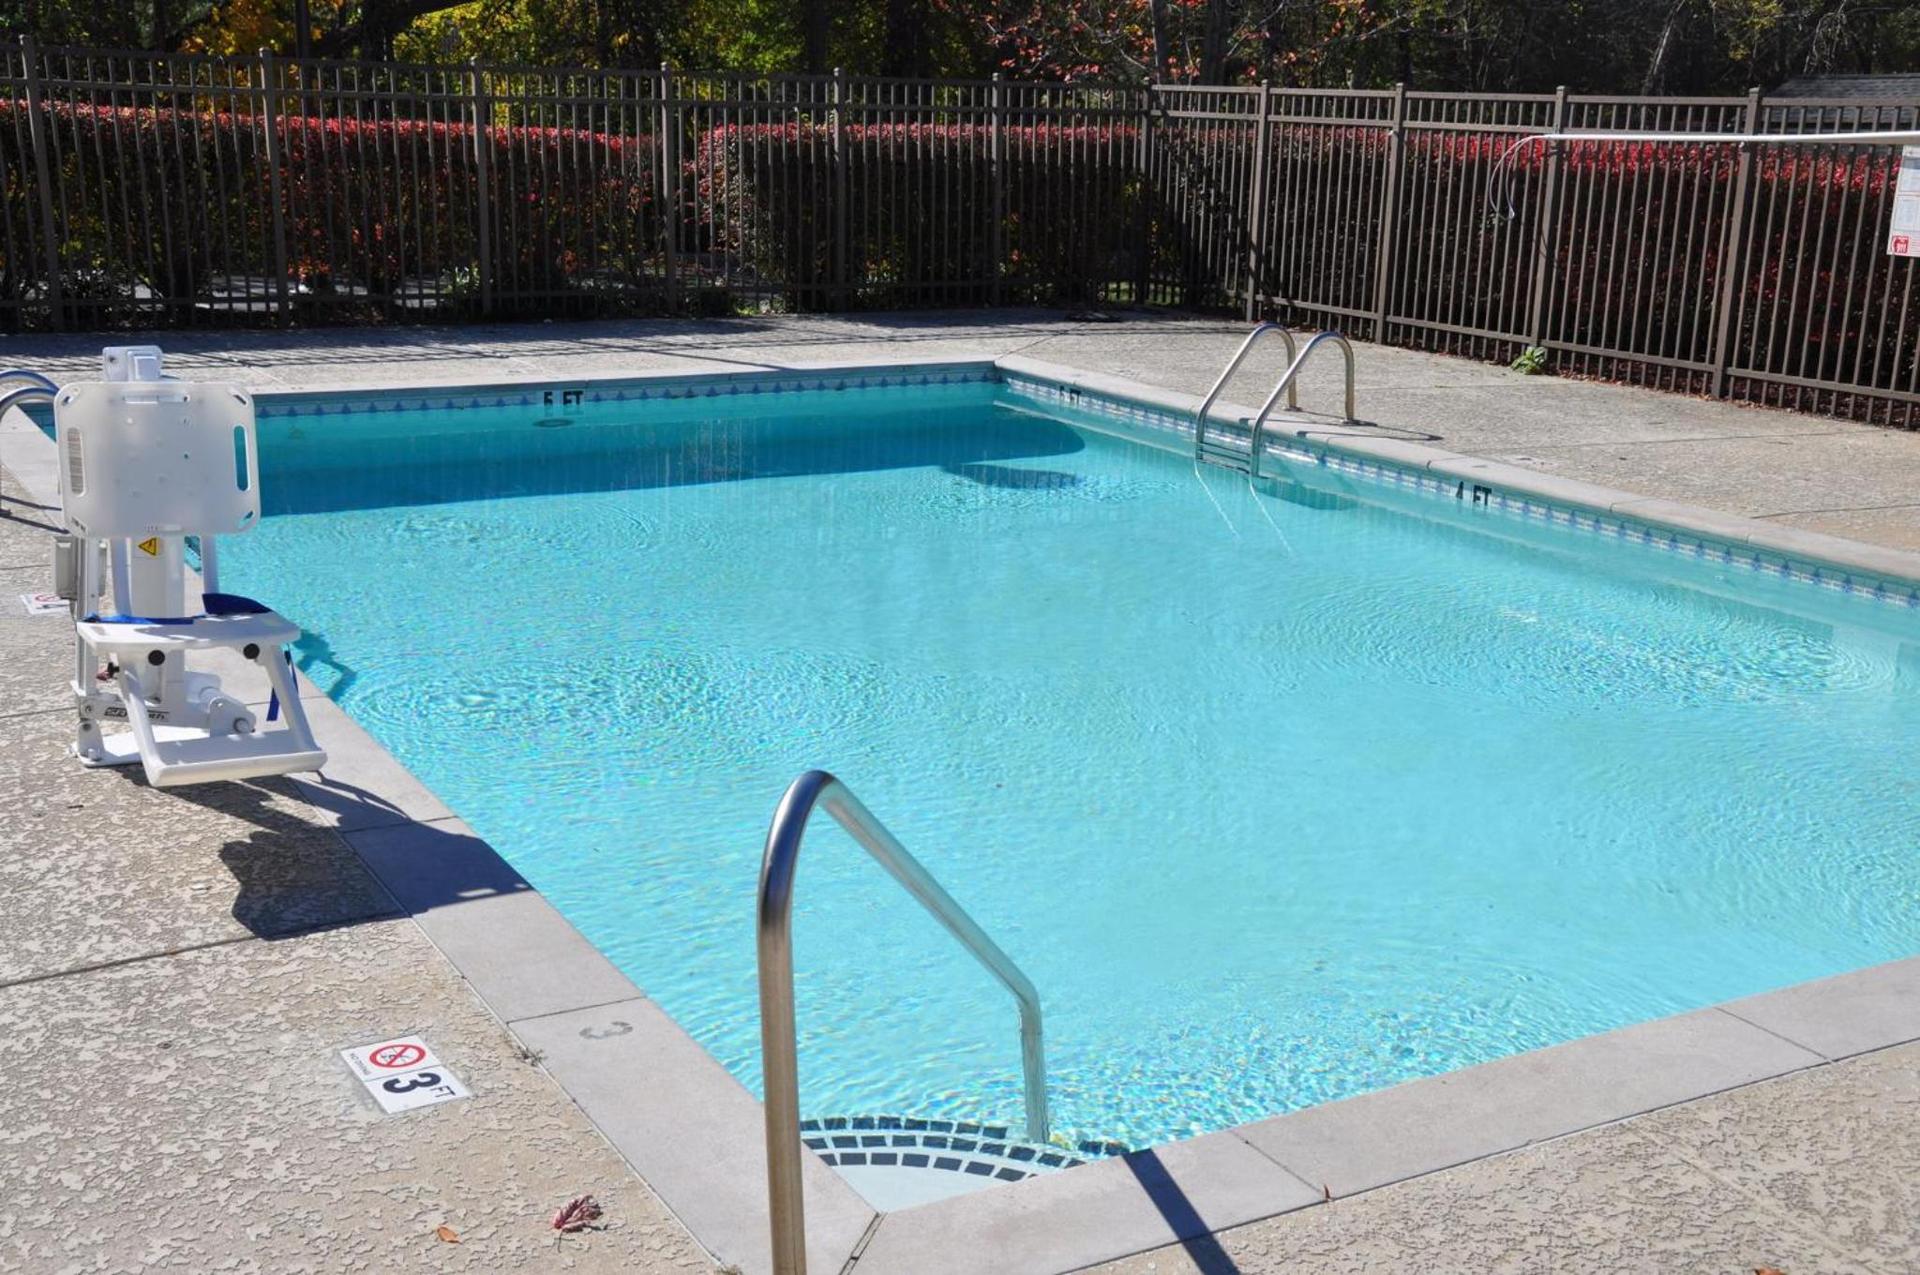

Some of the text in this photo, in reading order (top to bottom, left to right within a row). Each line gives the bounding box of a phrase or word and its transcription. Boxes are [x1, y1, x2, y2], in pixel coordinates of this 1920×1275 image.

[563, 390, 584, 406] FT
[1456, 481, 1492, 506] 4 FT
[578, 1021, 633, 1039] 3
[382, 1072, 456, 1098] 3 FT
